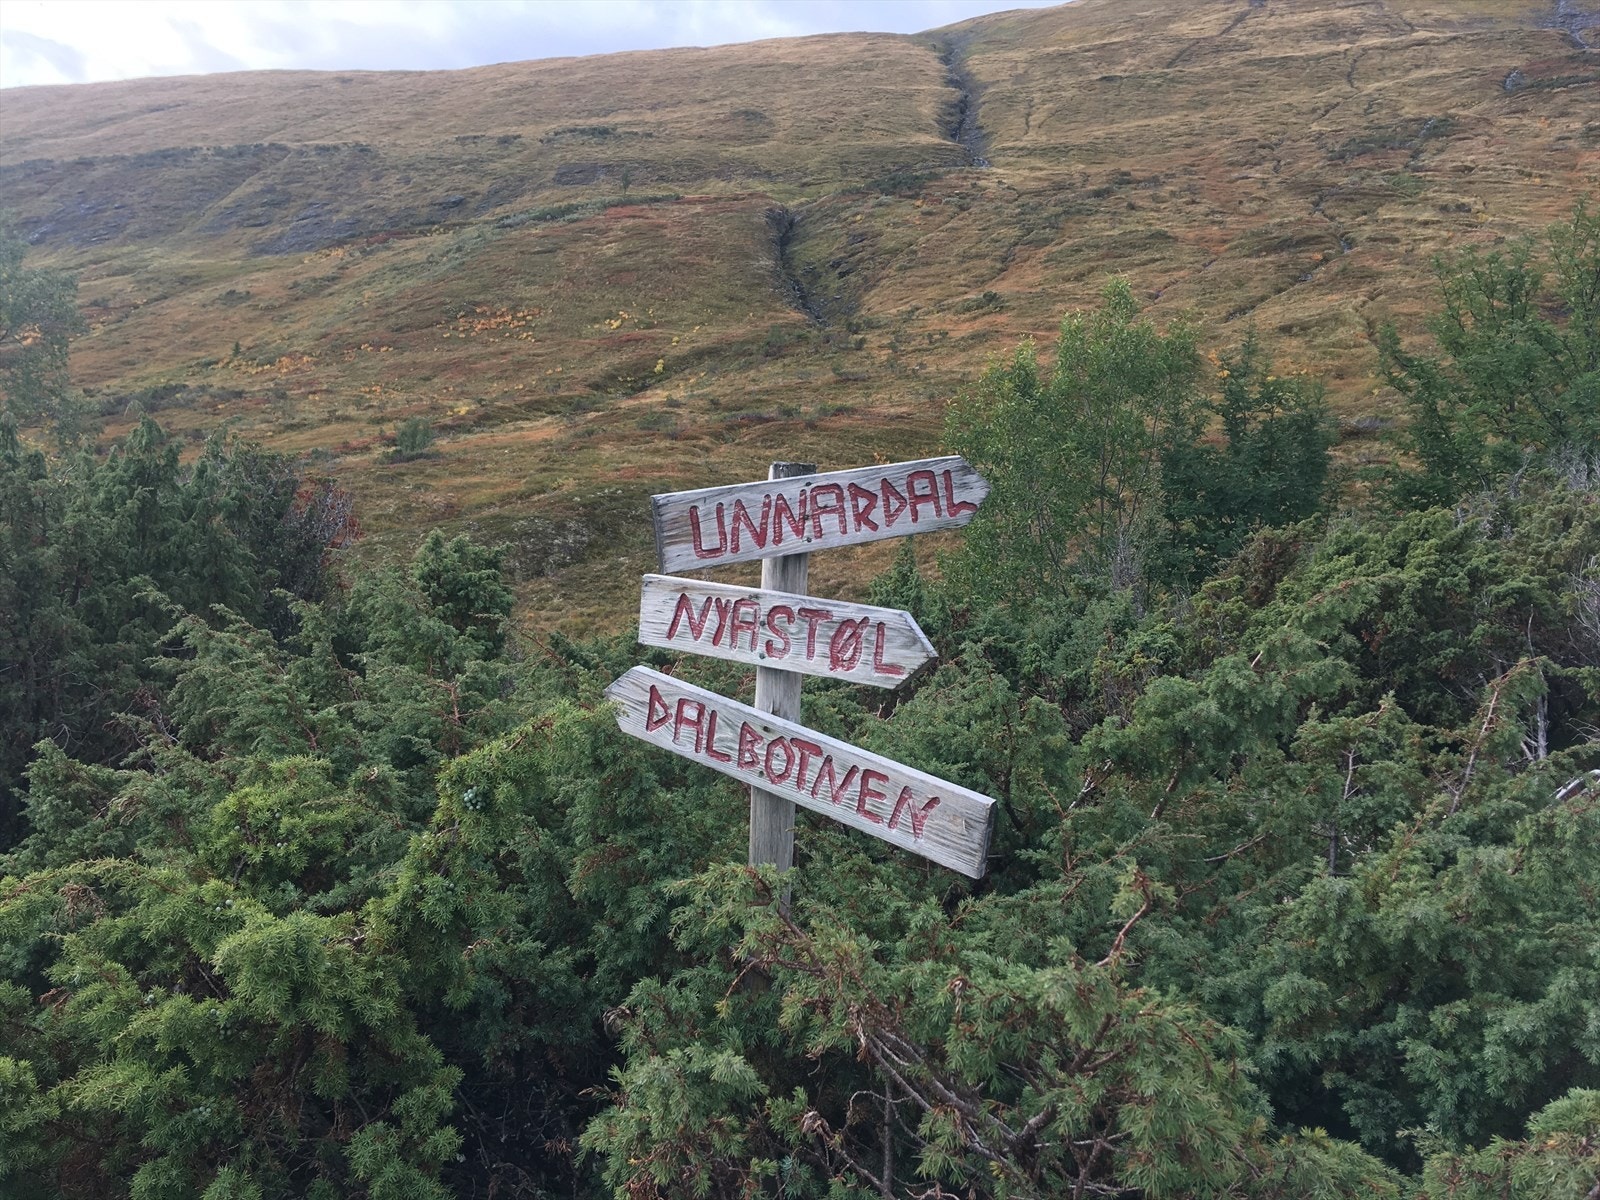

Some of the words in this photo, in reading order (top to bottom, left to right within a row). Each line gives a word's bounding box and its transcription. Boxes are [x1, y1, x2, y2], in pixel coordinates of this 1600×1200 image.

[689, 469, 978, 559] UNNARDAL
[666, 592, 906, 678] NYASTØL
[646, 684, 941, 841] DALBOTNEN
